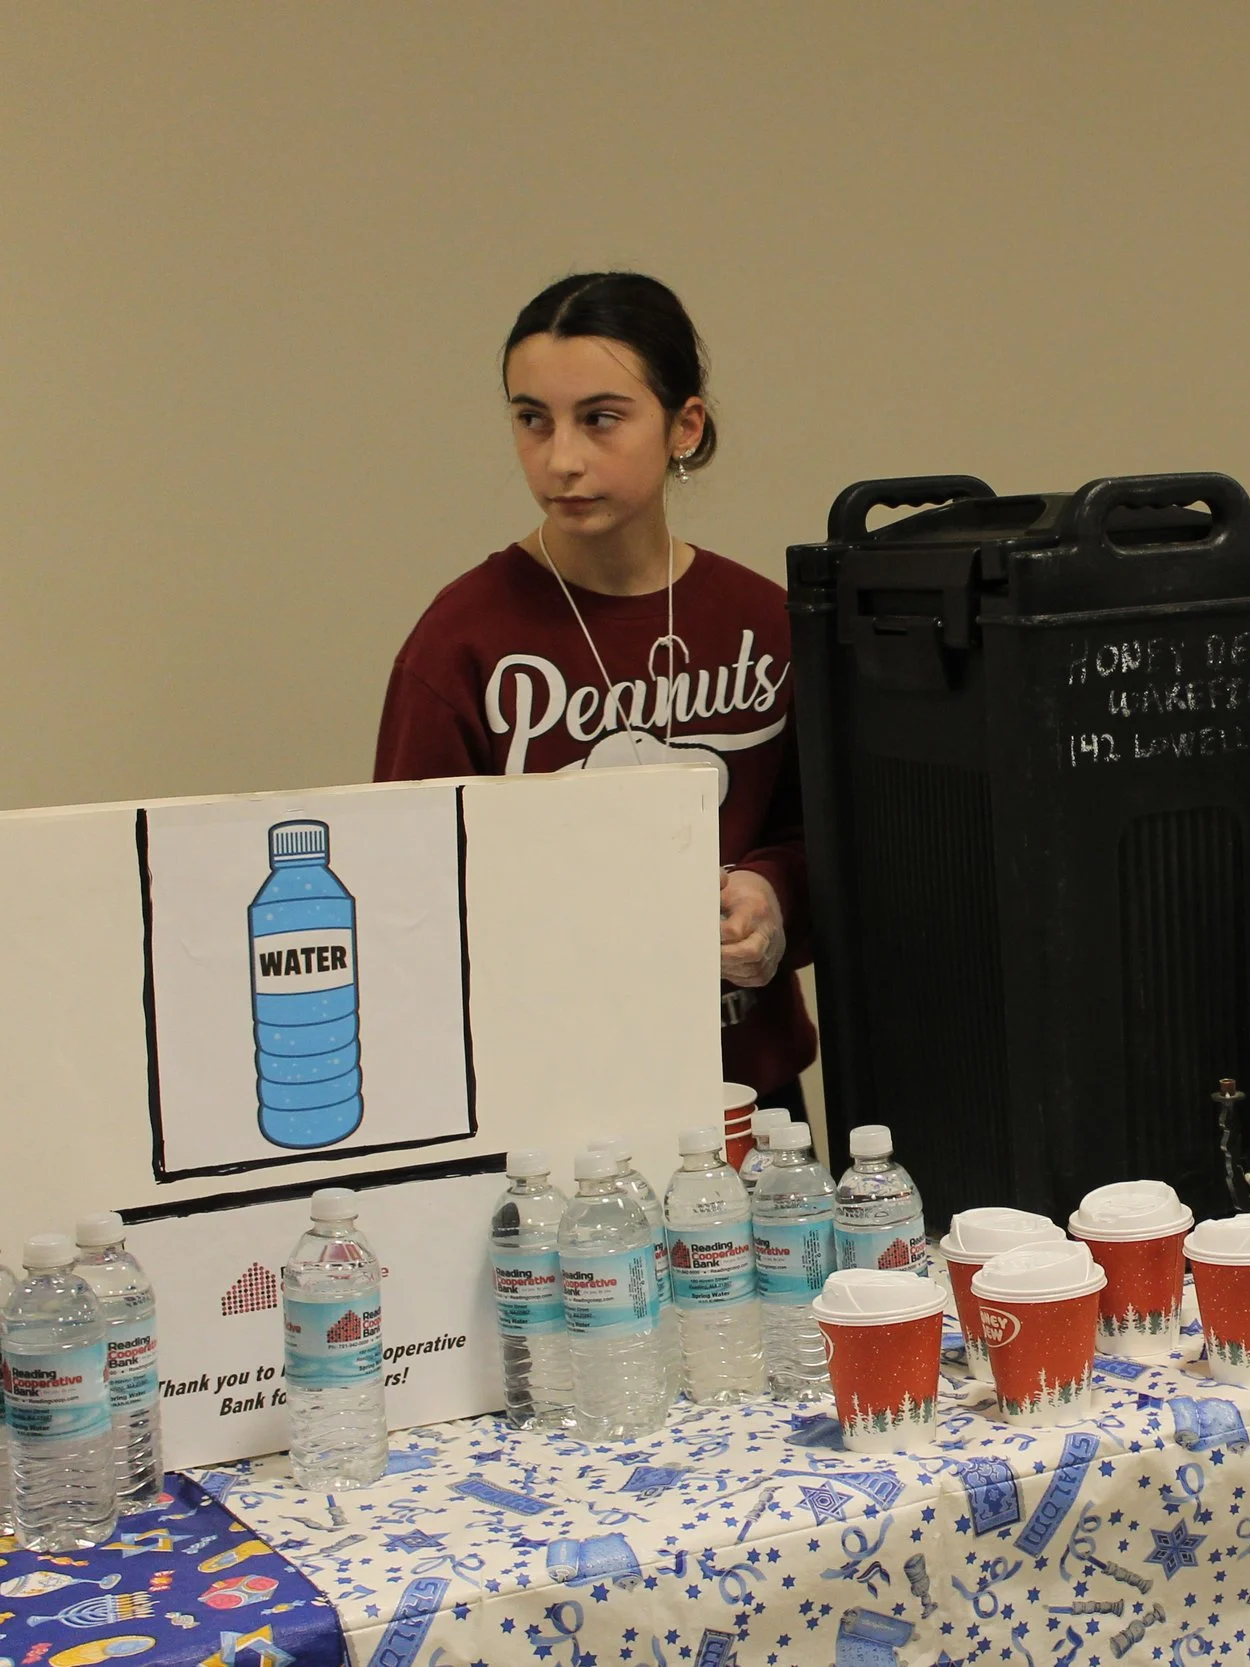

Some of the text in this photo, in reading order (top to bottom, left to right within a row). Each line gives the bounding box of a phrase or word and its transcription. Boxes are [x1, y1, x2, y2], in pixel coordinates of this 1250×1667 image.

[485, 629, 790, 776] Peanuts
[259, 945, 348, 977] WATER
[690, 1240, 733, 1253] Reading
[691, 1244, 750, 1261] Cooperative
[692, 1258, 720, 1269] Bank
[108, 1335, 151, 1351] Reading
[108, 1356, 138, 1369] Bank
[158, 1373, 210, 1398] Thank
[214, 1369, 250, 1394] you
[256, 1364, 275, 1382] to
[382, 1333, 467, 1364] operative
[12, 1367, 57, 1380] Reading
[13, 1374, 83, 1389] Cooperative
[13, 1386, 39, 1397] Bank
[219, 1367, 409, 1416] Bank fo rs!
